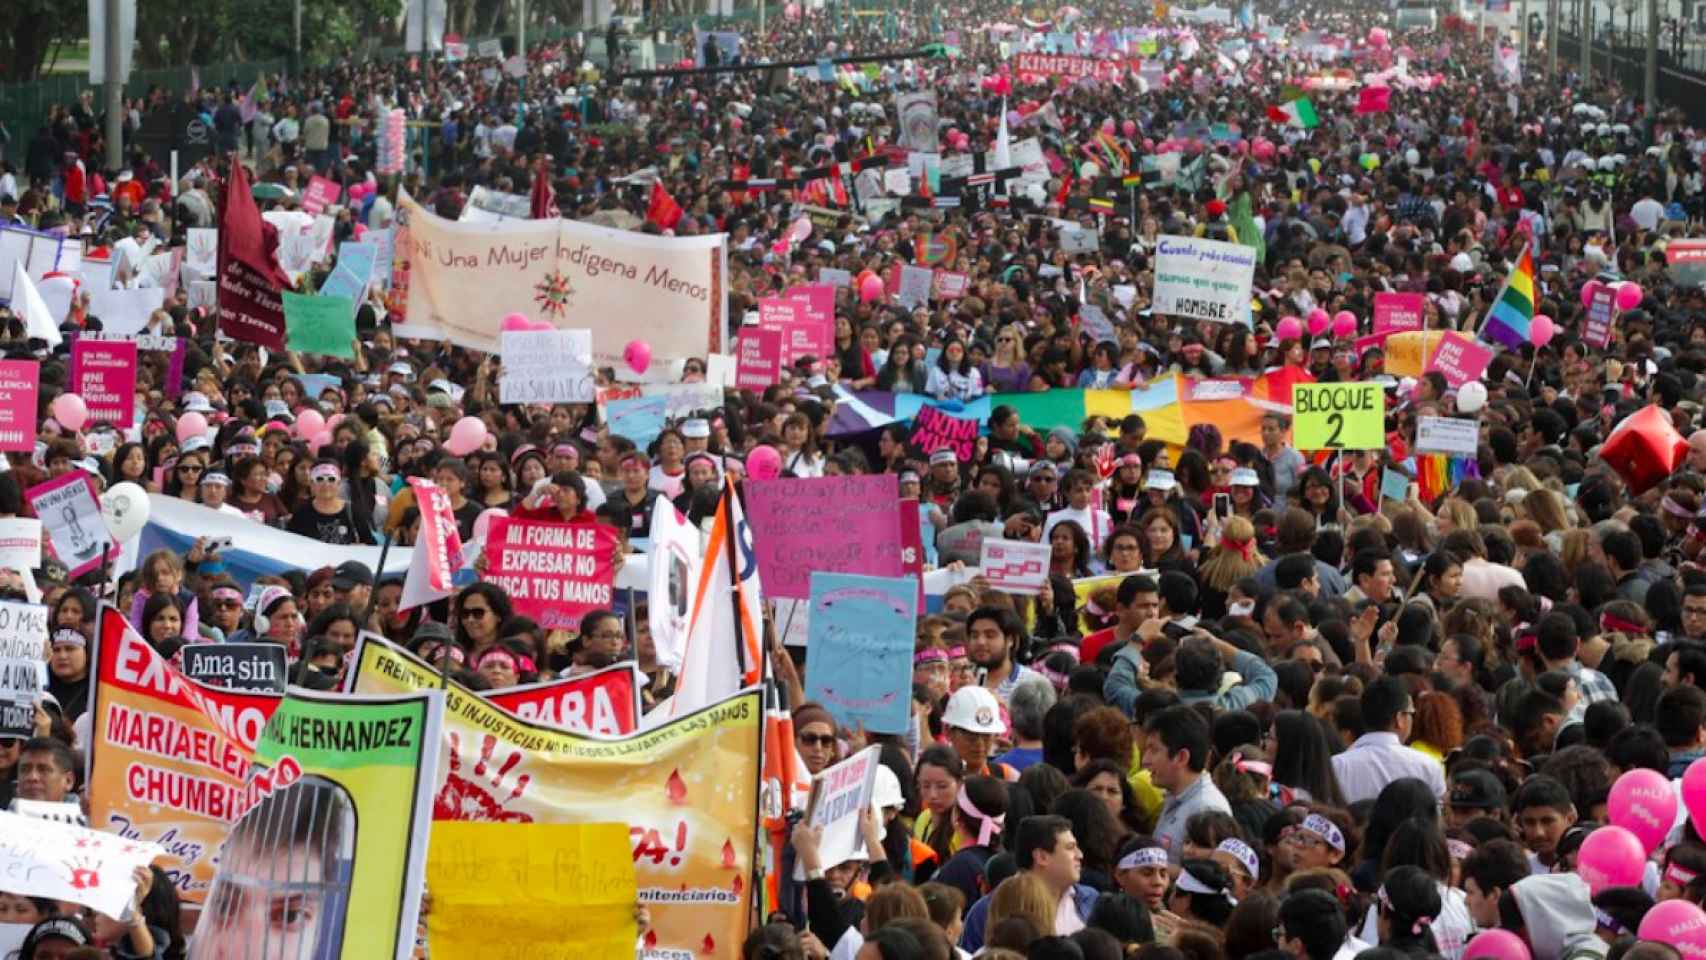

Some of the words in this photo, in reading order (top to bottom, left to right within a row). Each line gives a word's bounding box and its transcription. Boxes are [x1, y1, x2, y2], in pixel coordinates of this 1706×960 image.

[416, 243, 432, 260] Ni
[439, 250, 478, 267] Una
[488, 244, 548, 271] Mujer
[556, 237, 637, 279] Indígena
[644, 265, 709, 301] Menos
[1324, 412, 1346, 447] 2
[506, 524, 522, 544] MI
[526, 526, 573, 549] FORMA
[576, 529, 595, 550] DE
[501, 550, 572, 575] EXPRESAR
[575, 553, 597, 576] NO
[533, 578, 560, 601] TUS
[562, 581, 610, 605] MANOS
[191, 653, 235, 676] Ama
[238, 656, 276, 681] sin
[290, 716, 412, 752] HERNANDEZ
[462, 700, 545, 752] INJUSTICIAS
